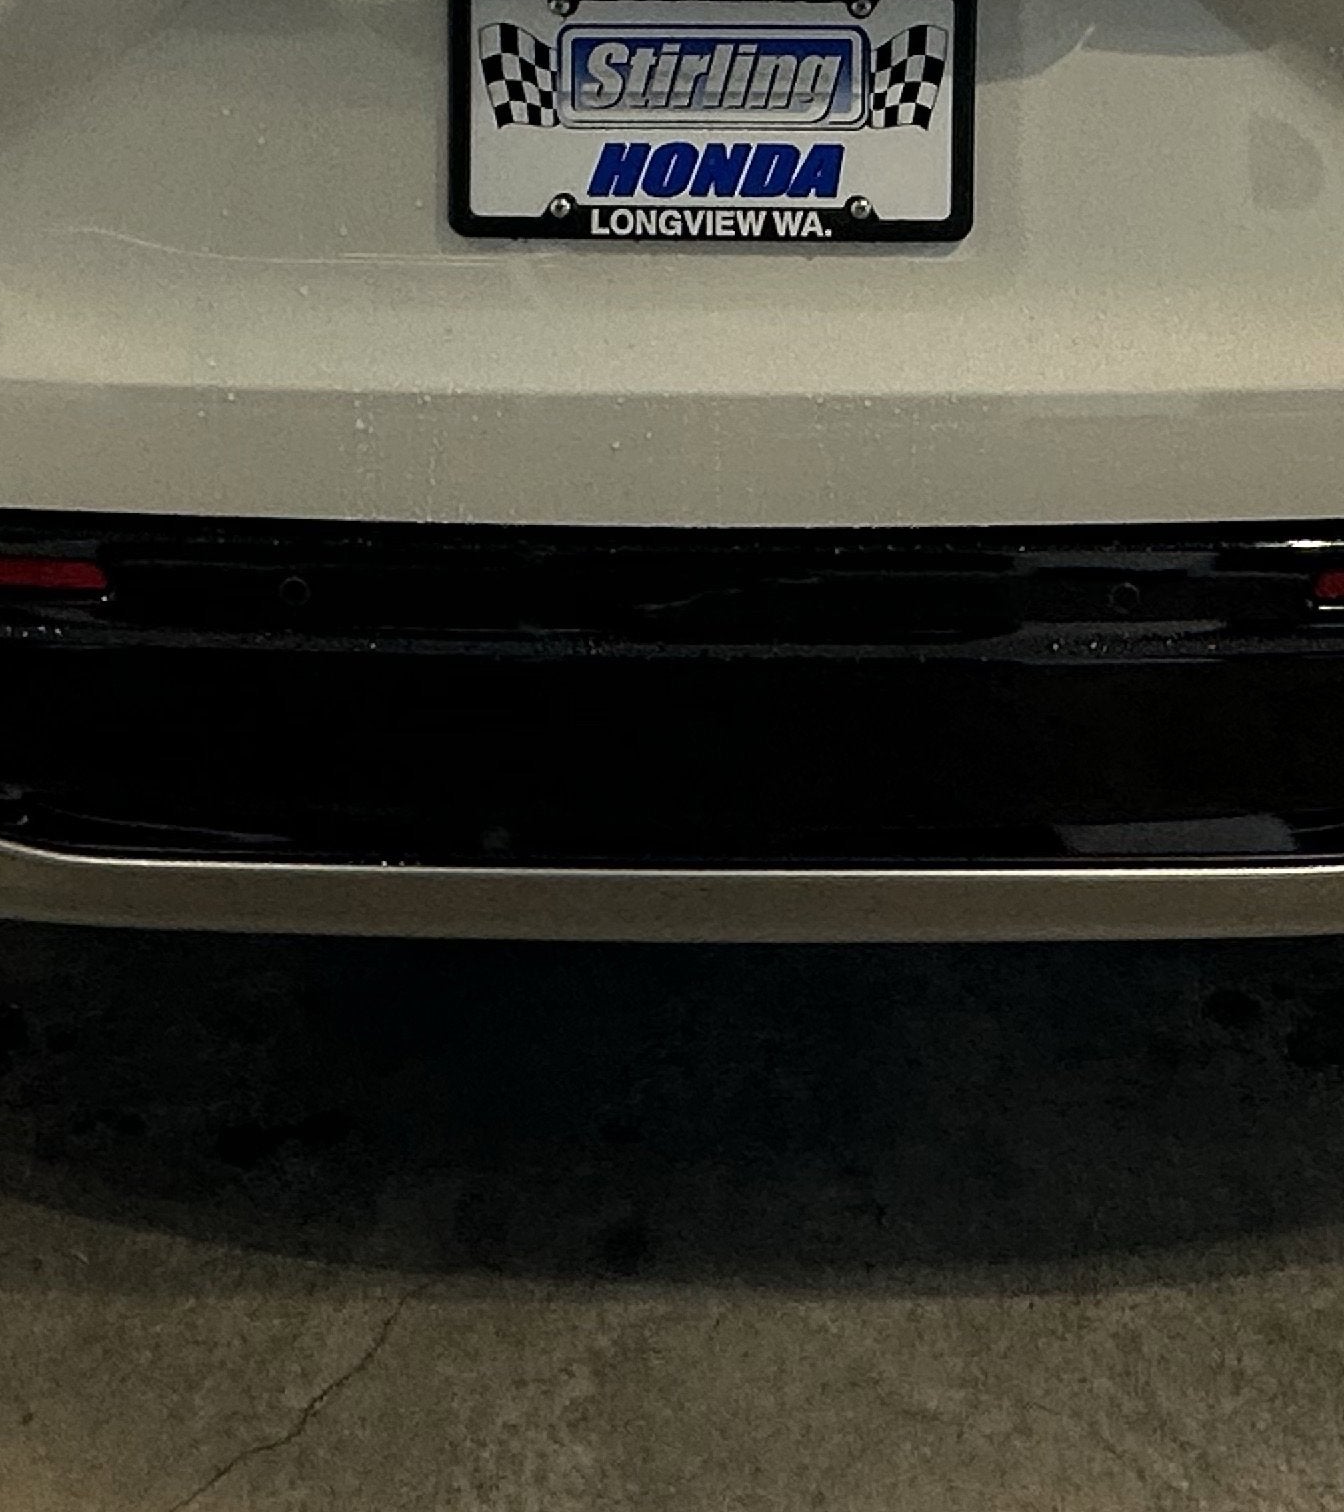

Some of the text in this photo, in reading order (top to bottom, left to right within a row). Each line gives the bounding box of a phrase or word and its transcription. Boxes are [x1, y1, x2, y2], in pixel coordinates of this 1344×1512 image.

[581, 42, 842, 123] Stirling
[587, 141, 845, 198] HONDA
[590, 208, 833, 237] LONGVIEW WA.
